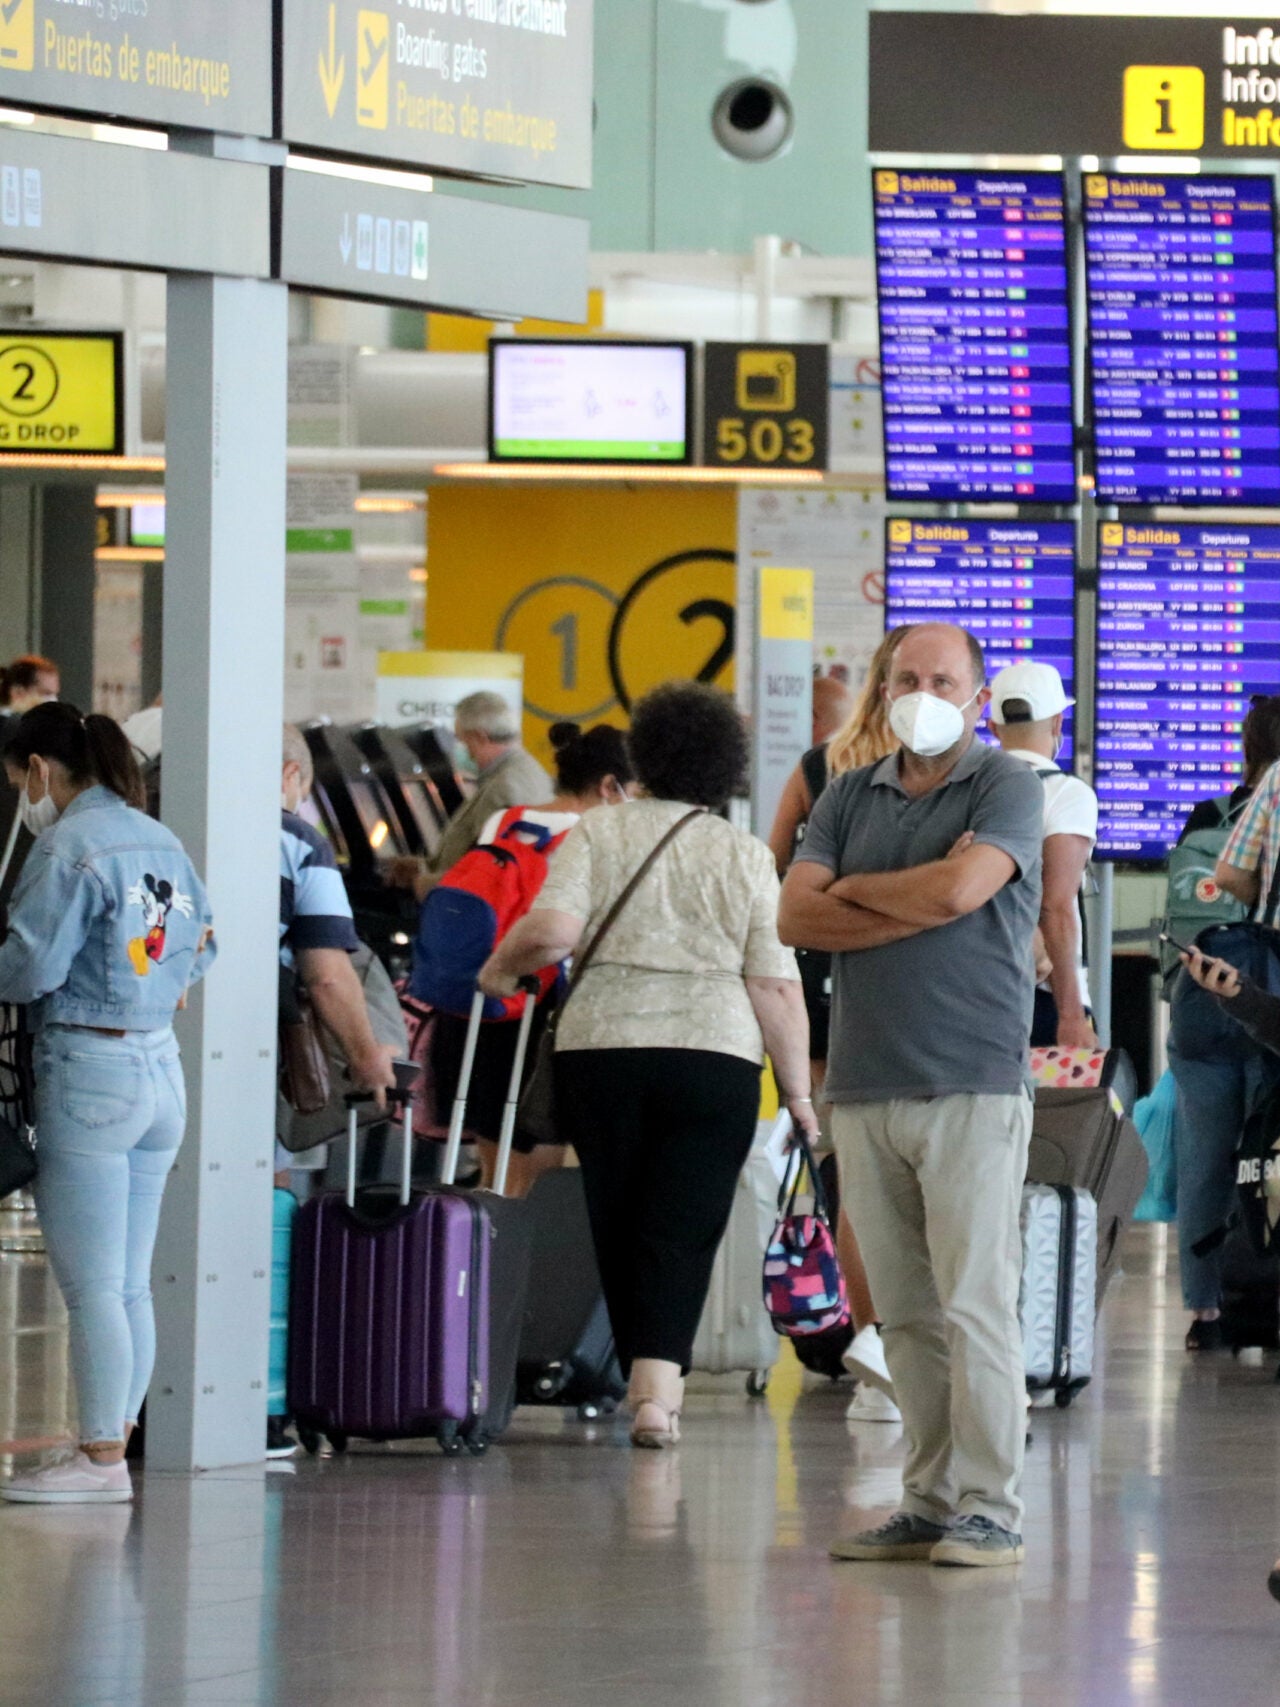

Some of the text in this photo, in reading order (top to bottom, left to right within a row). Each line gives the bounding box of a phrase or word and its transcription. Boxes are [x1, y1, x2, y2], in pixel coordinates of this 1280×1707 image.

[44, 19, 229, 106] Puertas de embarque
[396, 22, 488, 82] Boarding gates
[396, 80, 557, 159] Puertas de embarque
[900, 177, 1026, 193] Salidas Departures
[1110, 181, 1235, 196] Salidas Departures
[11, 362, 35, 400] 2
[18, 425, 79, 442] DROP
[717, 419, 814, 463] 503
[913, 526, 1038, 541] Salidas Departures
[1126, 529, 1250, 545] Salidas Departures
[548, 613, 578, 690] 1
